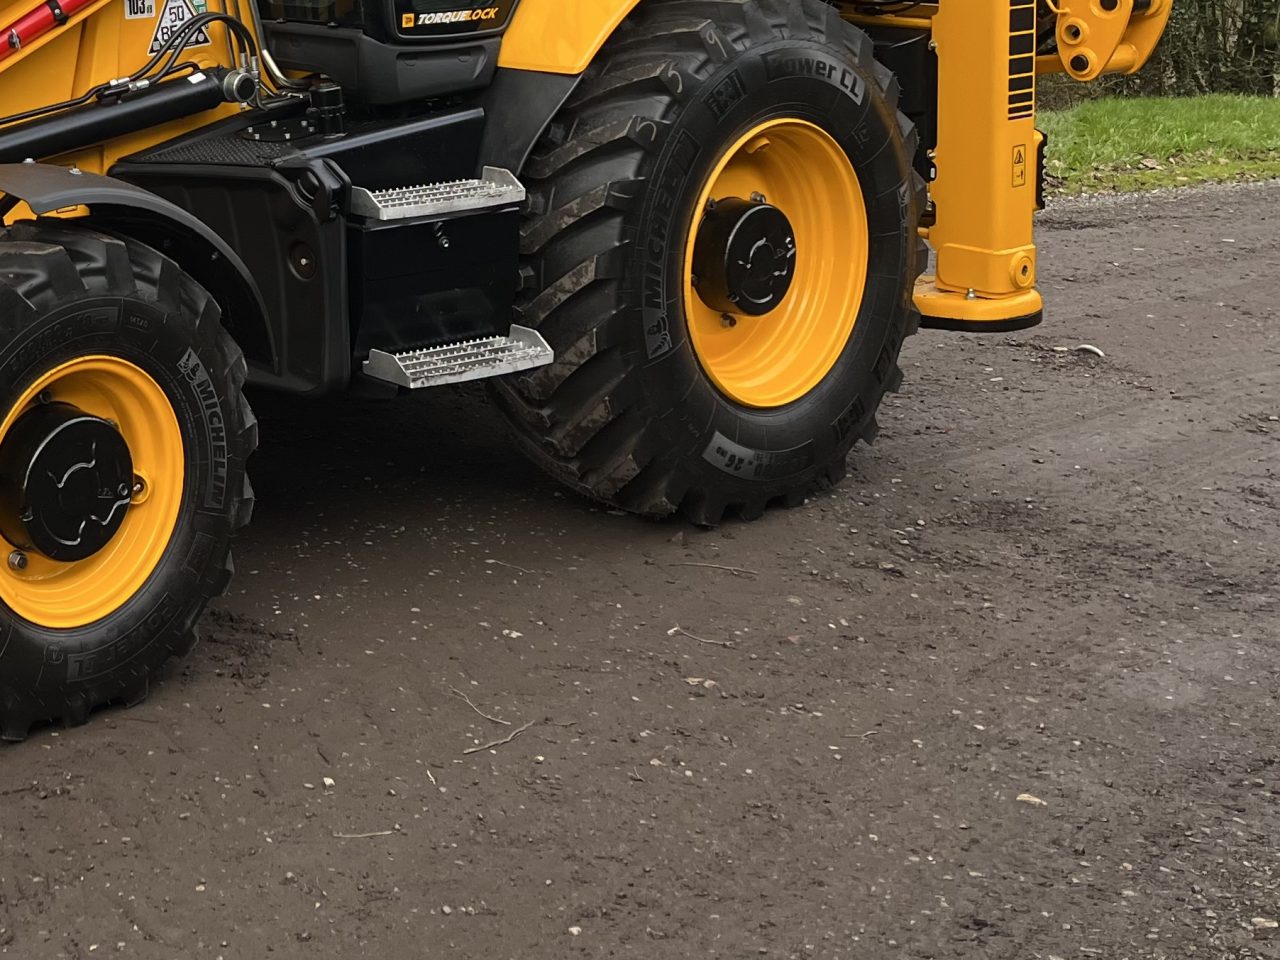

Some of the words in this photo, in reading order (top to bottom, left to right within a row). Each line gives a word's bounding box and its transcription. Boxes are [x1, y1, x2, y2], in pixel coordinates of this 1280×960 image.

[417, 8, 498, 25] TORQUELOCK
[840, 67, 860, 98] CL
[645, 134, 698, 309] MICHEL
[196, 378, 226, 506] MICHELIN
